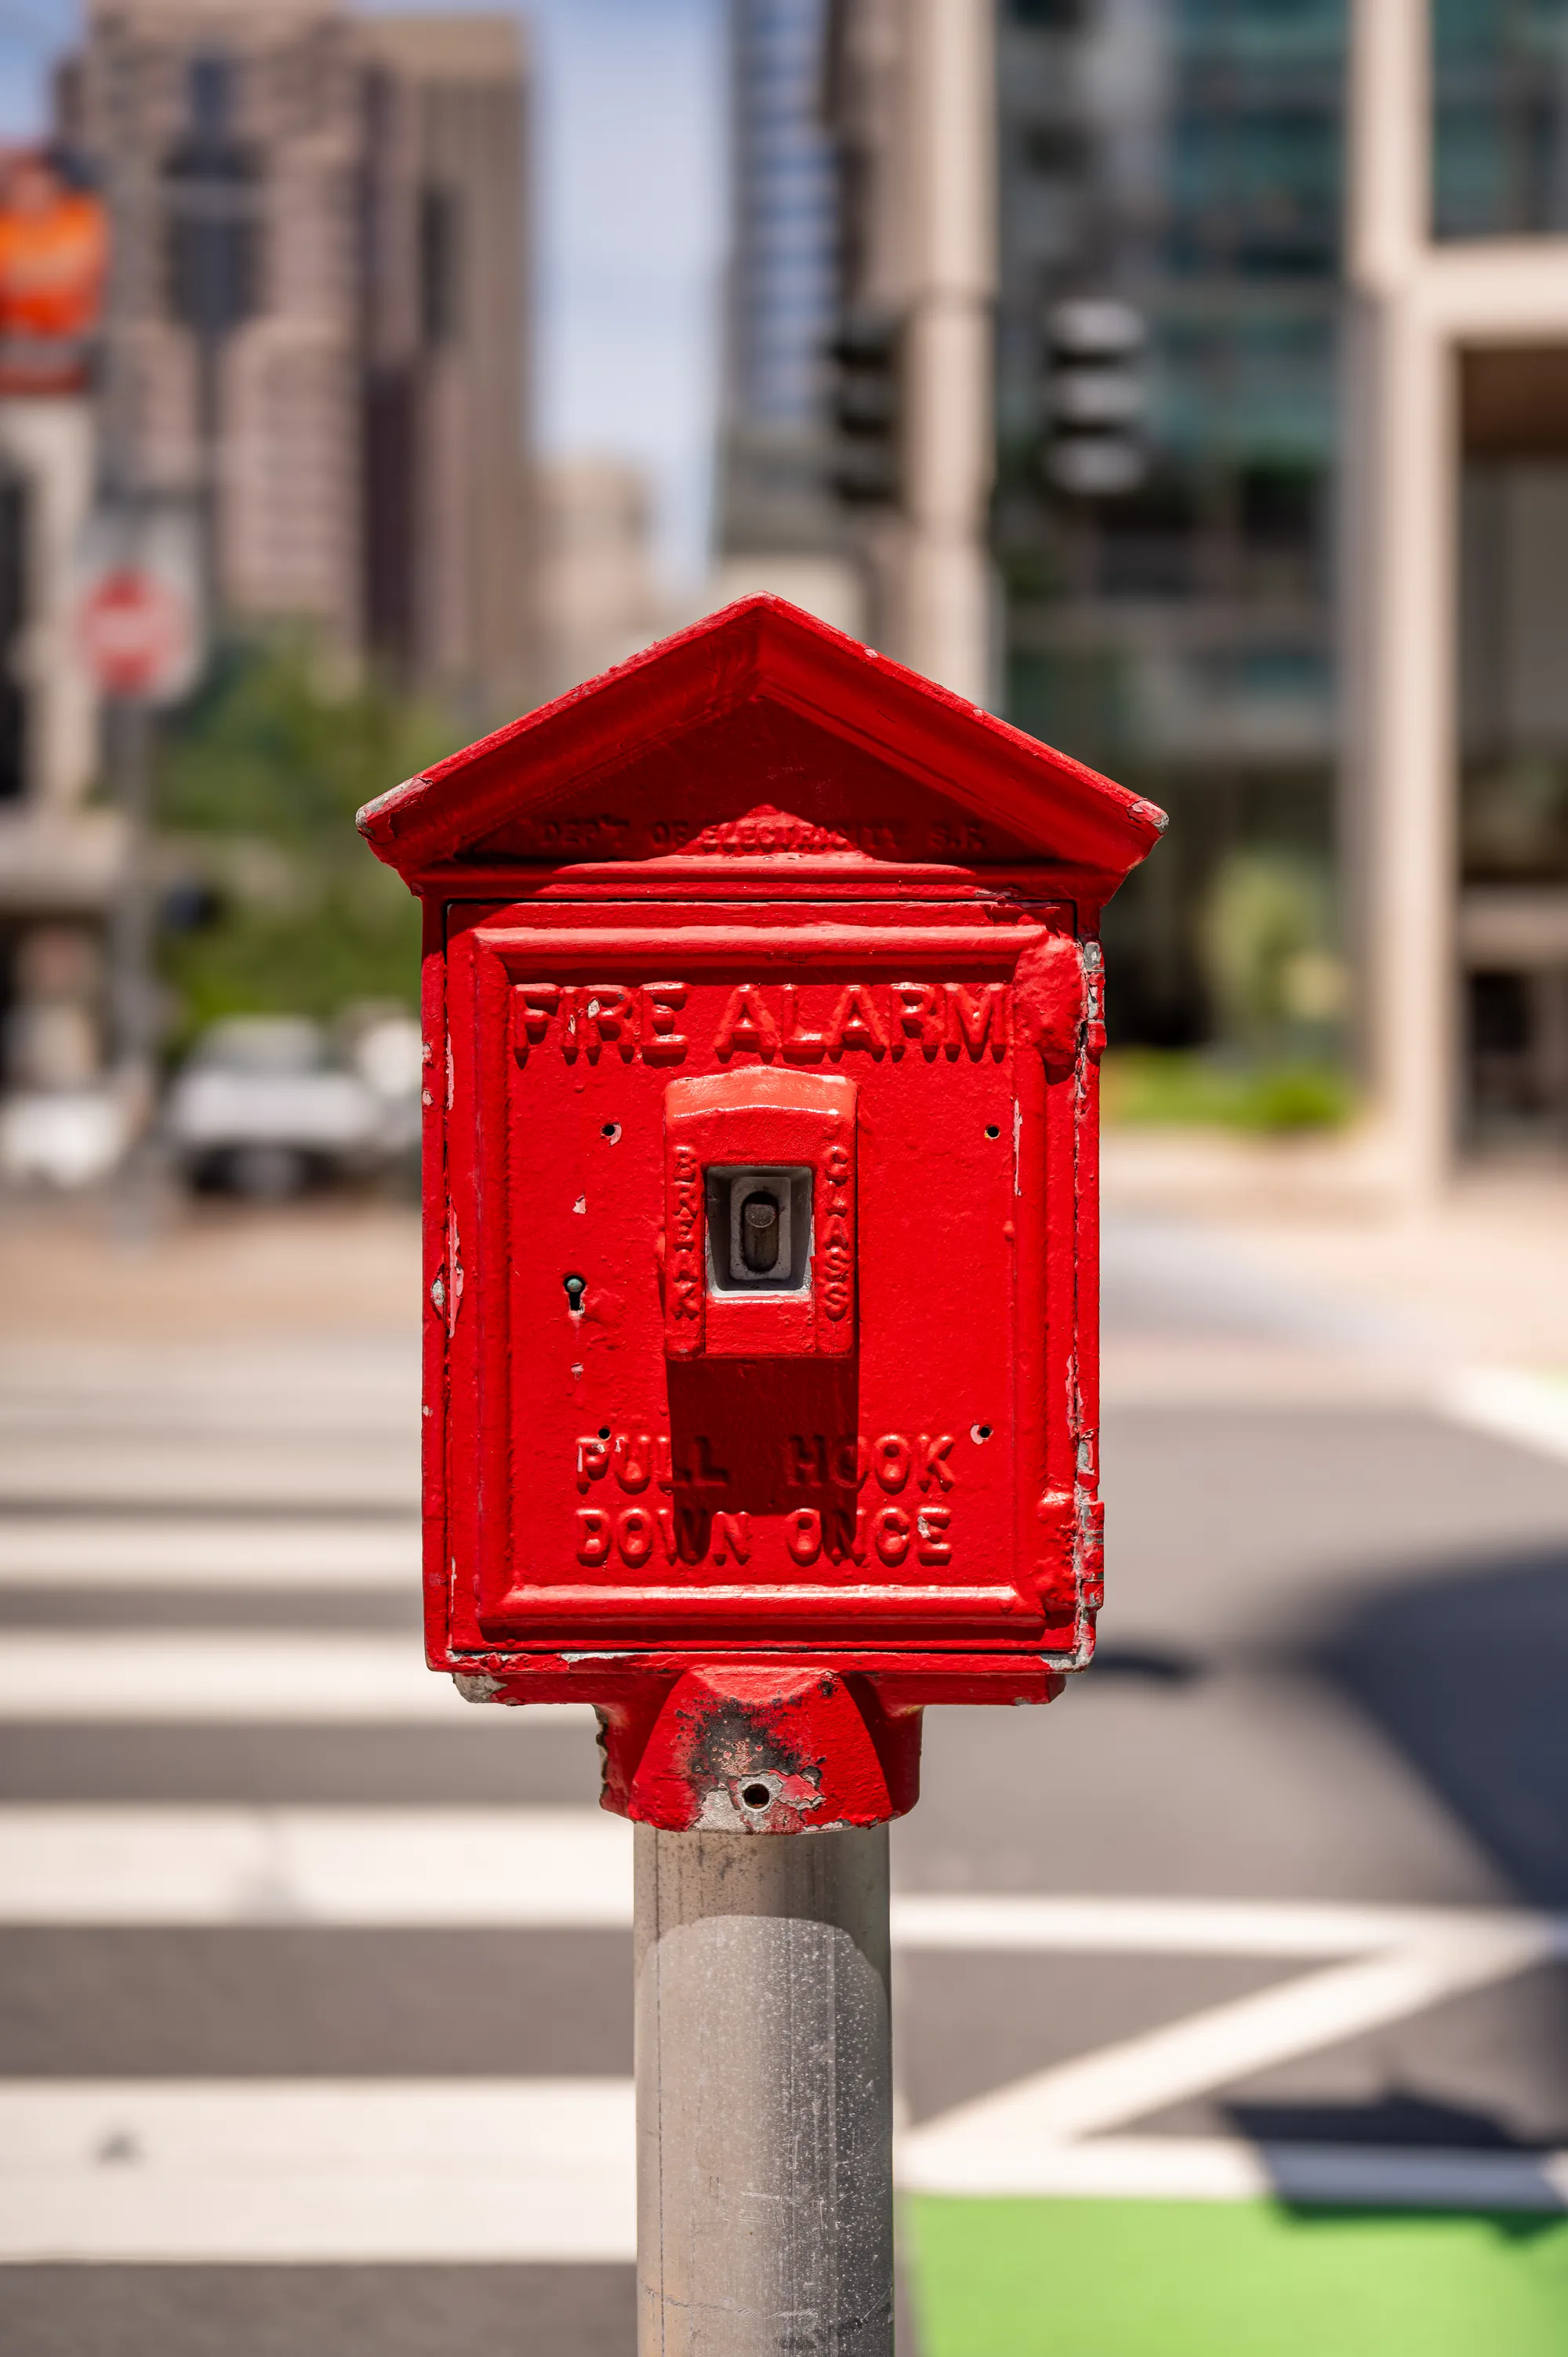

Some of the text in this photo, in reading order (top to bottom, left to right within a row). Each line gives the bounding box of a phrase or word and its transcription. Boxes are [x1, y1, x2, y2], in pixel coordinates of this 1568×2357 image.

[650, 820, 690, 851] OF
[513, 982, 1009, 1051] FIRE ALARM
[670, 1145, 699, 1319] BREAK
[823, 1145, 853, 1320] GLASS
[574, 1433, 956, 1488] PULL HOOK
[574, 1506, 952, 1560] DOWN ONCE
